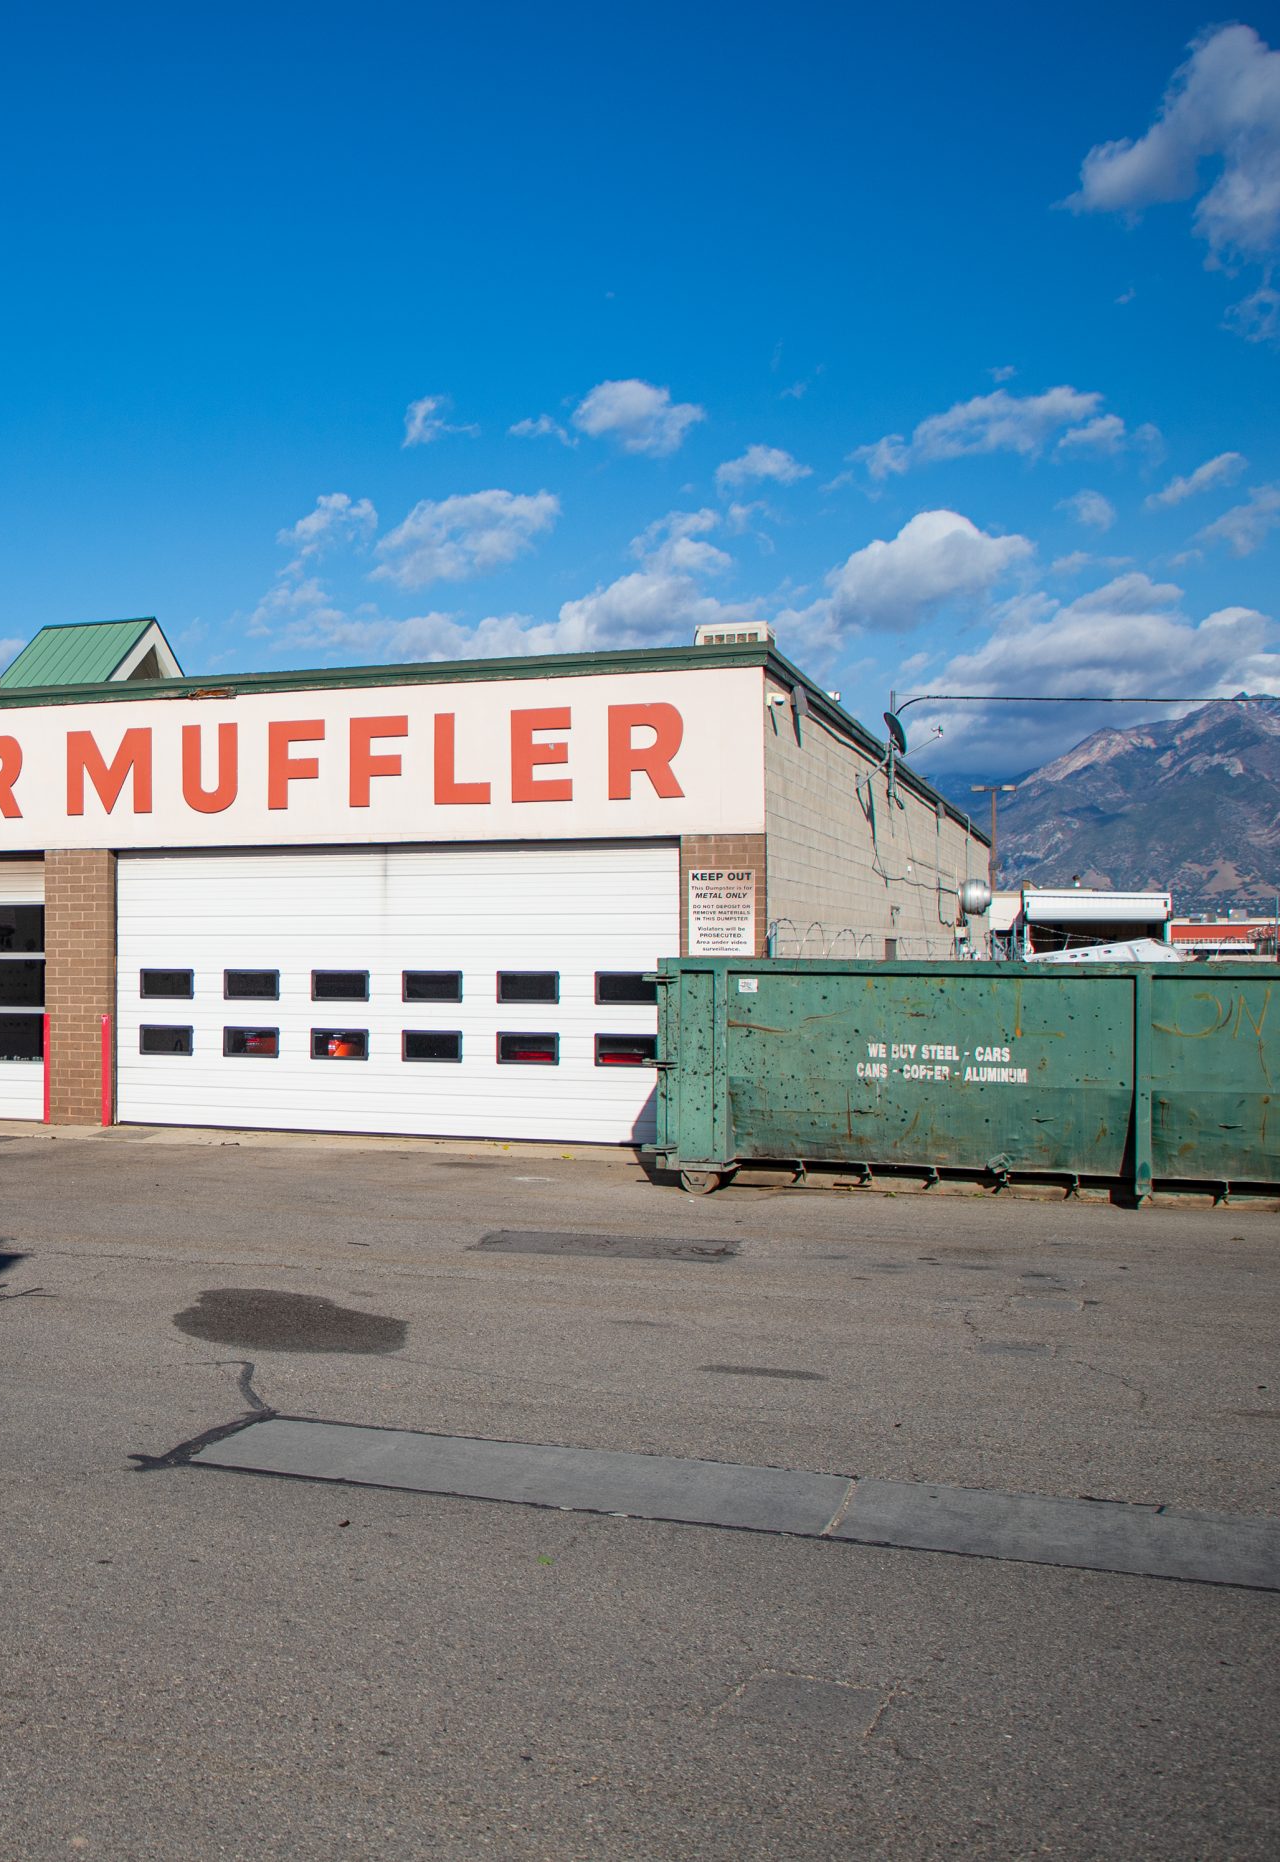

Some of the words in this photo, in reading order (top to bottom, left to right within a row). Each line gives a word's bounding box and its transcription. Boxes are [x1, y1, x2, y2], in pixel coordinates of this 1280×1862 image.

[66, 702, 686, 816] MUFFLER
[691, 872, 724, 881] KEEP
[727, 872, 752, 881] OUT
[867, 1042, 887, 1058] WE
[891, 1043, 917, 1060] BUY
[921, 1044, 960, 1061] STEEL
[974, 1046, 1011, 1063] CARS
[856, 1062, 888, 1079] CANS
[964, 1066, 1028, 1084] ALUMINUM
